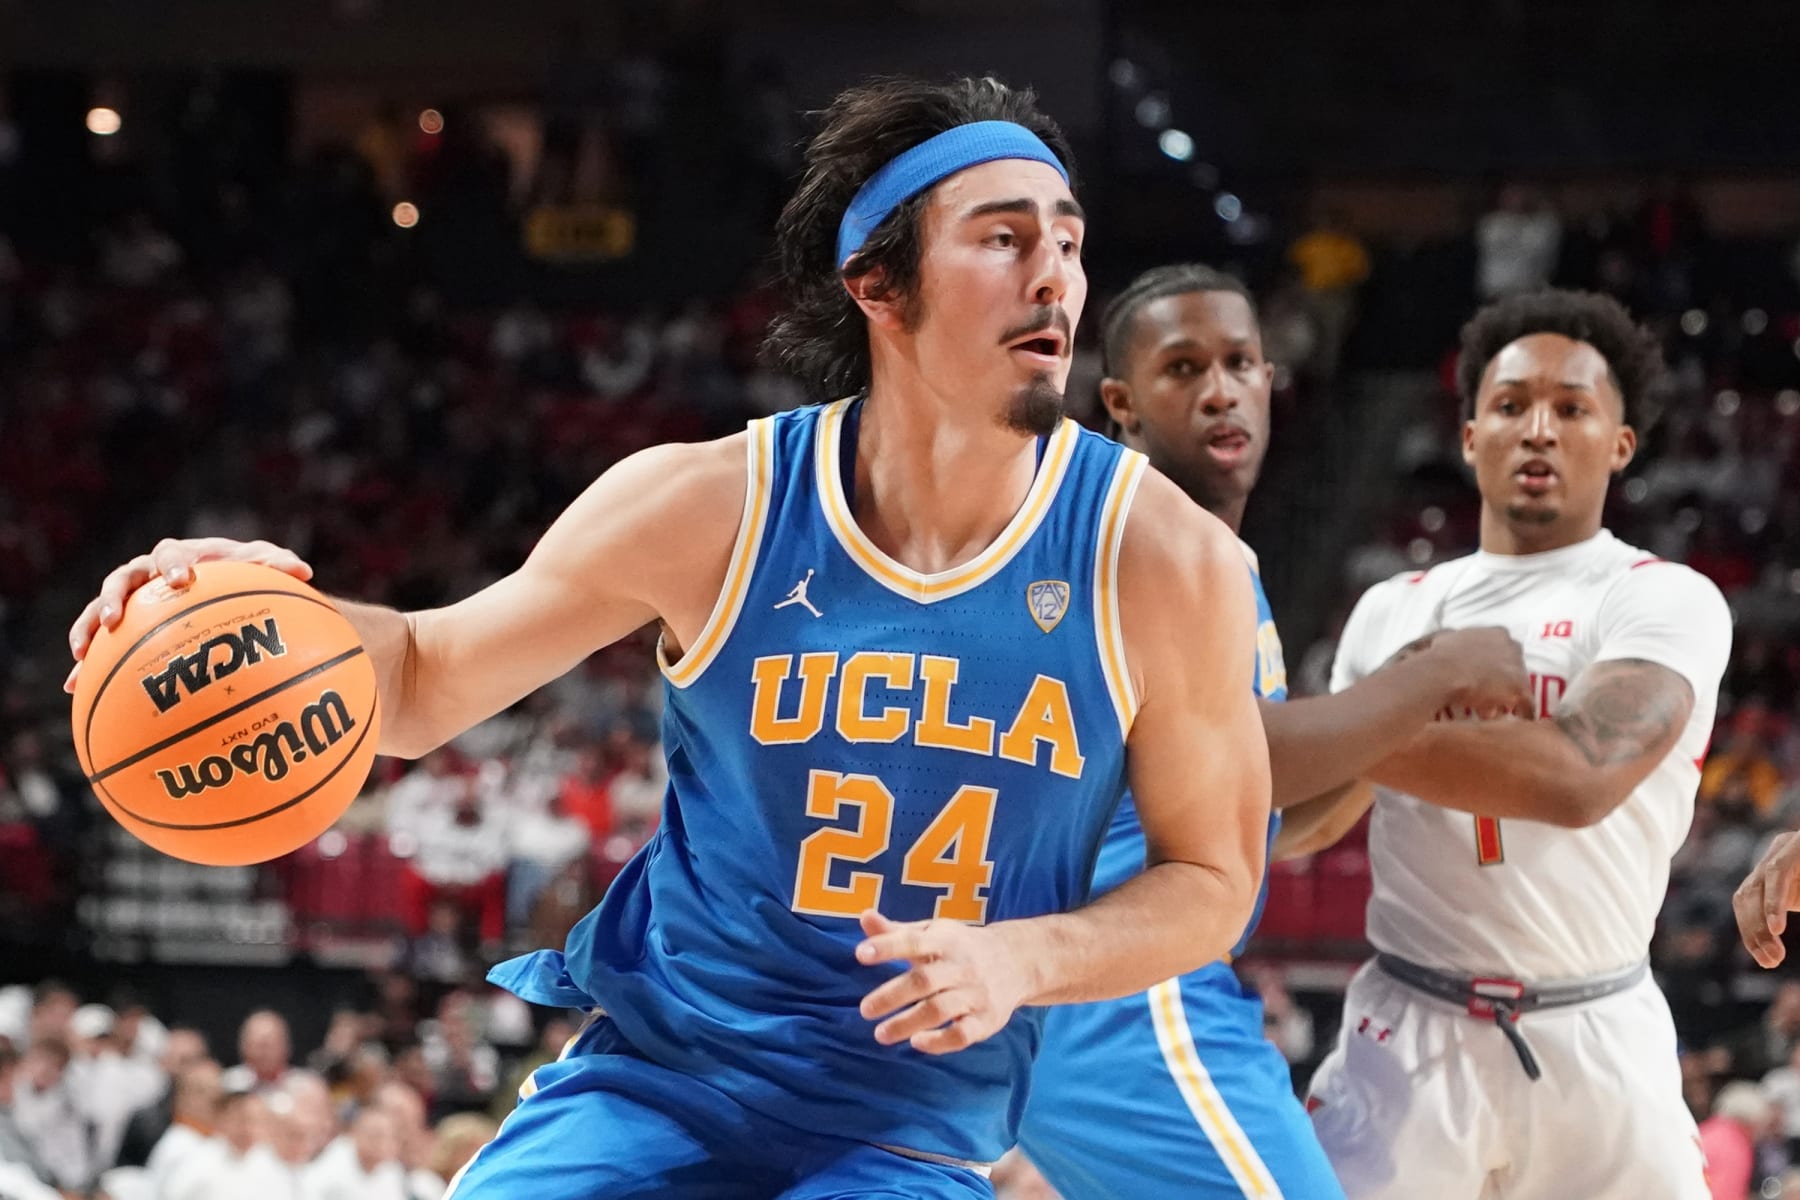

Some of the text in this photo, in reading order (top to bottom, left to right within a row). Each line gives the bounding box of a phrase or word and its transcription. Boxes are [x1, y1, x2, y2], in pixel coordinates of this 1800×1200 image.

[213, 607, 271, 630] OFFICIAL
[1038, 603, 1058, 620] 12
[140, 617, 287, 714] NCAA
[156, 689, 356, 799] Wilson
[221, 712, 279, 746] EVO NXT
[750, 651, 1086, 779] UCLA
[792, 769, 999, 926] 24
